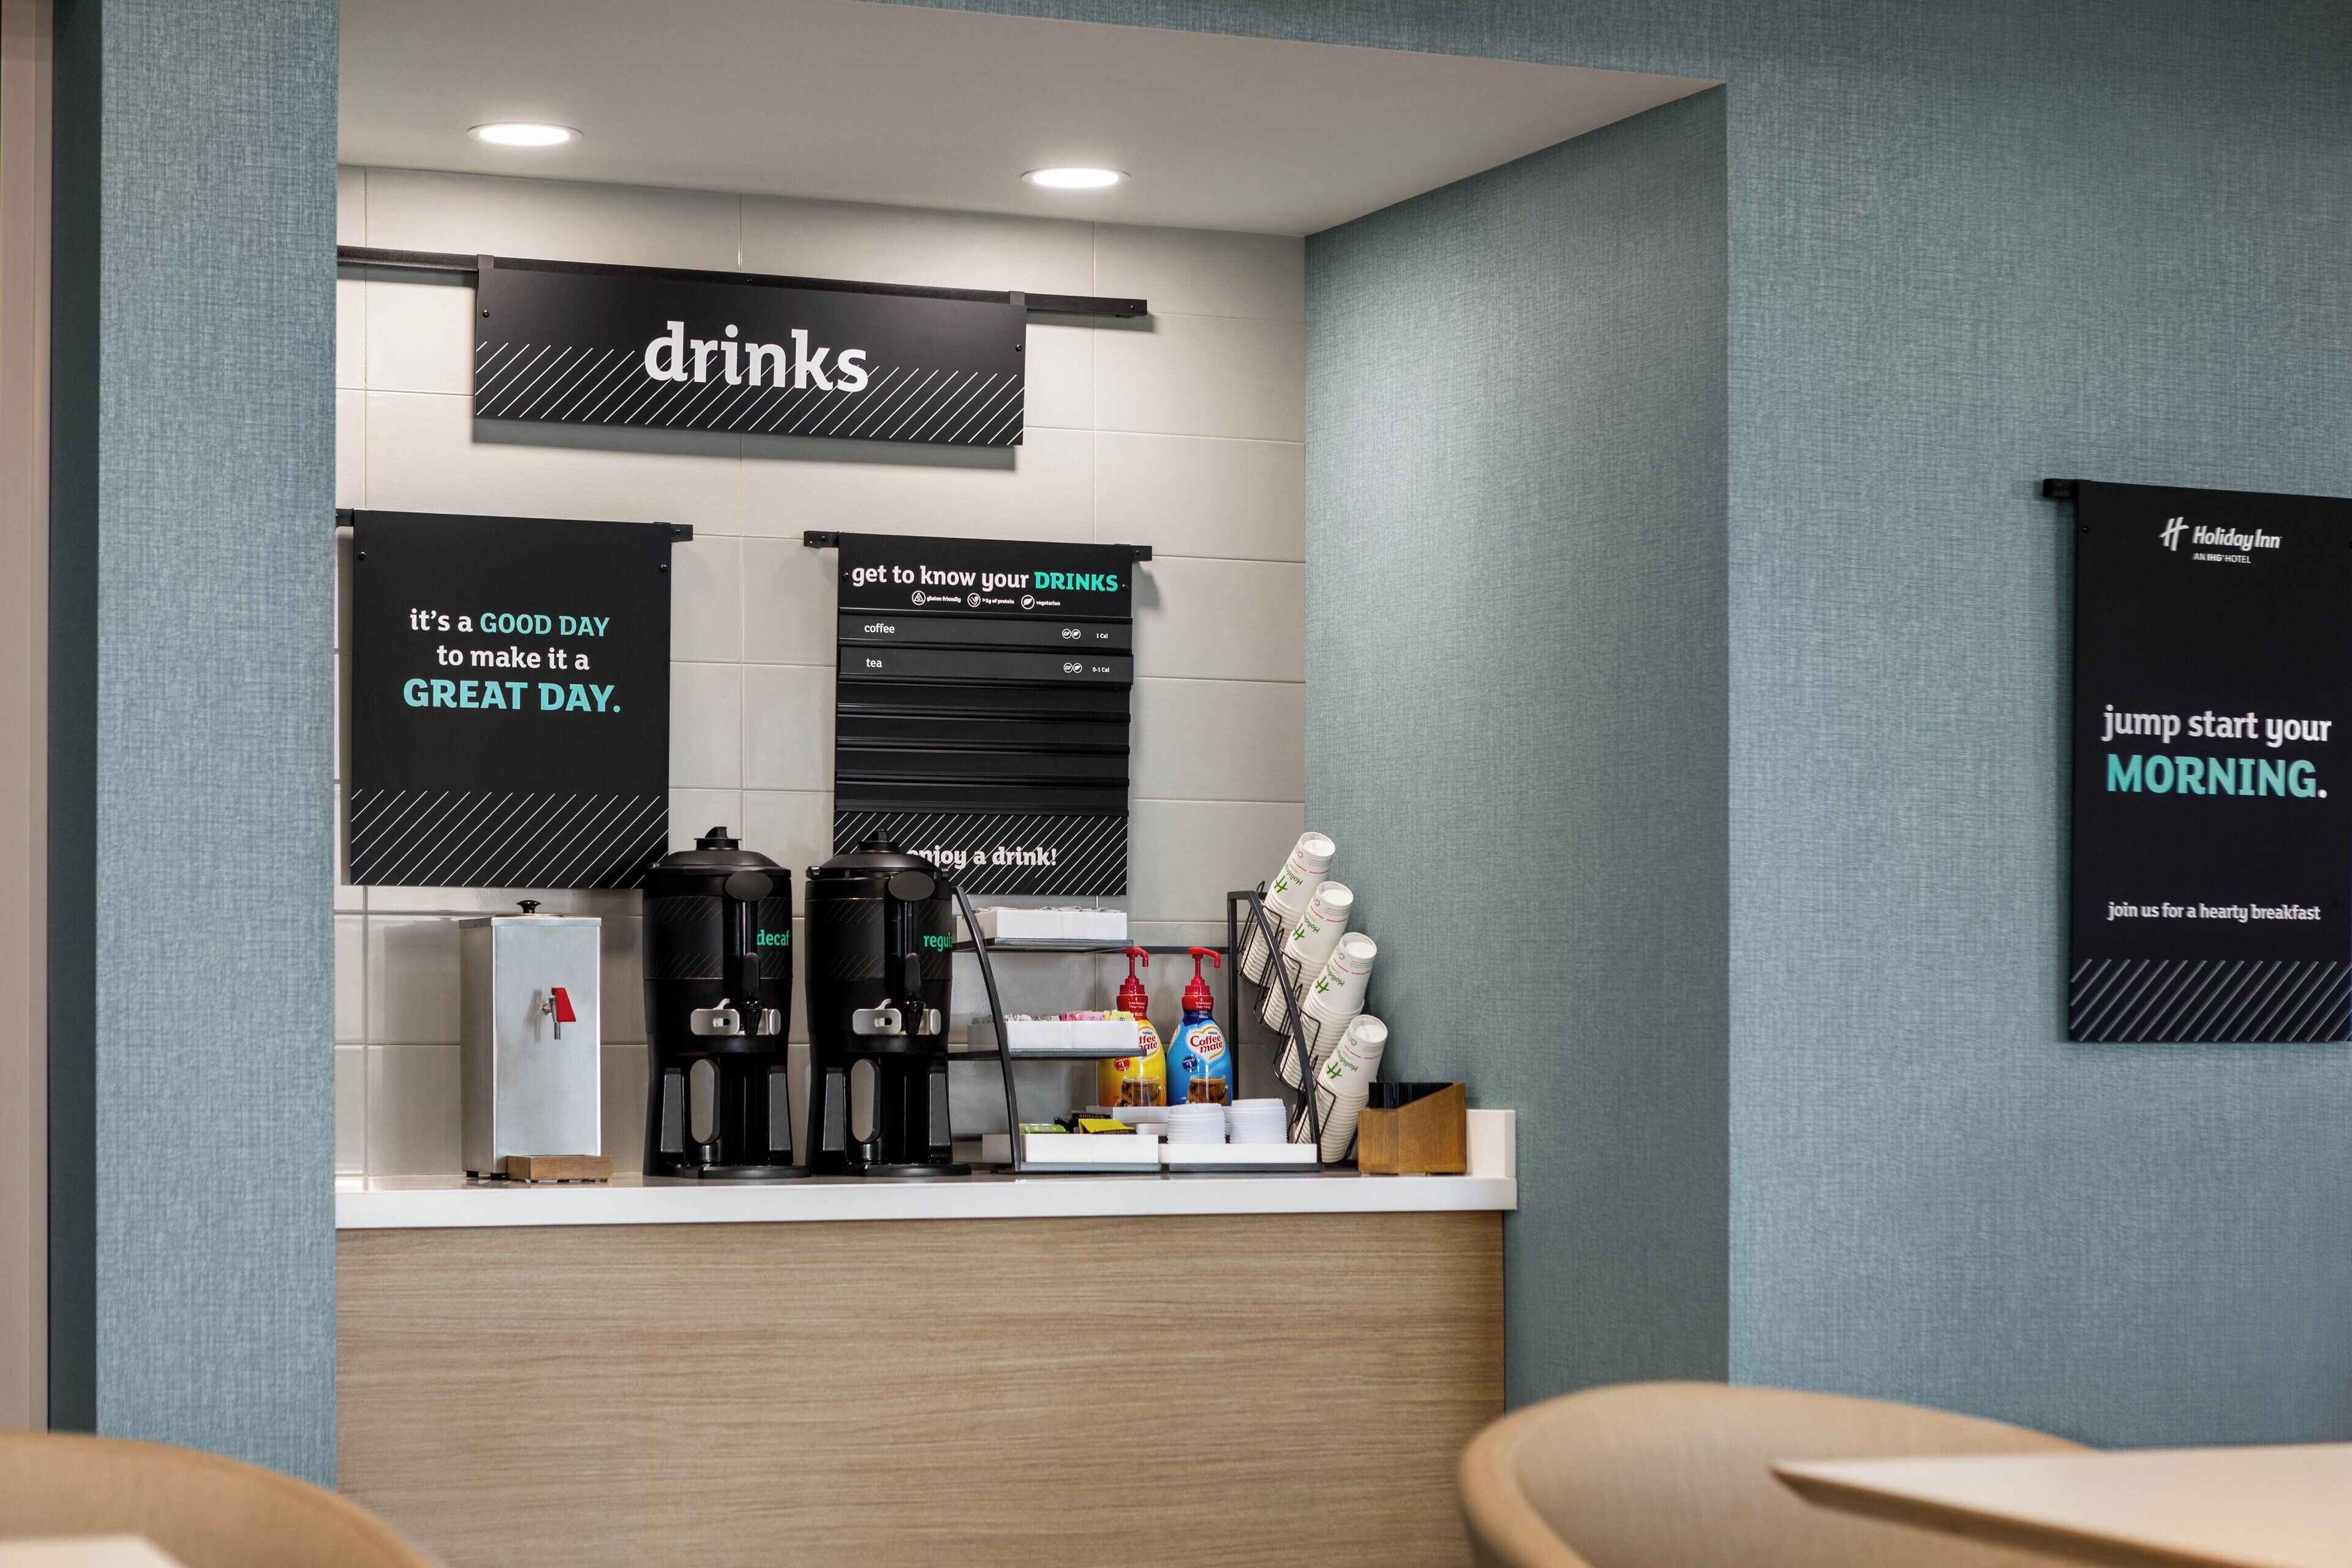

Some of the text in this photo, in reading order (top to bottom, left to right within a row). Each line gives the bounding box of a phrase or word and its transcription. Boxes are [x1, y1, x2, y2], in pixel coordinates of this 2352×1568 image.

[644, 320, 869, 393] drinks
[2192, 526, 2254, 551] Holiday
[2254, 529, 2281, 549] Inn
[2225, 554, 2252, 564] HOTEL
[852, 565, 1118, 592] get to know your DRINKS
[410, 608, 610, 637] it’s a GOOD DAY
[864, 623, 895, 634] coffee
[437, 645, 590, 671] to make it a
[866, 658, 883, 668] tea
[404, 678, 620, 713] GREAT DAY.
[2101, 704, 2332, 748] jump start your
[2106, 753, 2328, 799] MORNING.
[973, 851, 987, 865] a
[992, 846, 1057, 865] drink!
[2106, 901, 2321, 924] join us for a hearty breakfast
[757, 929, 790, 946] decaf
[1139, 1035, 1156, 1044] ffee
[1190, 1035, 1221, 1047] Coffee
[1200, 1041, 1223, 1053] mate
